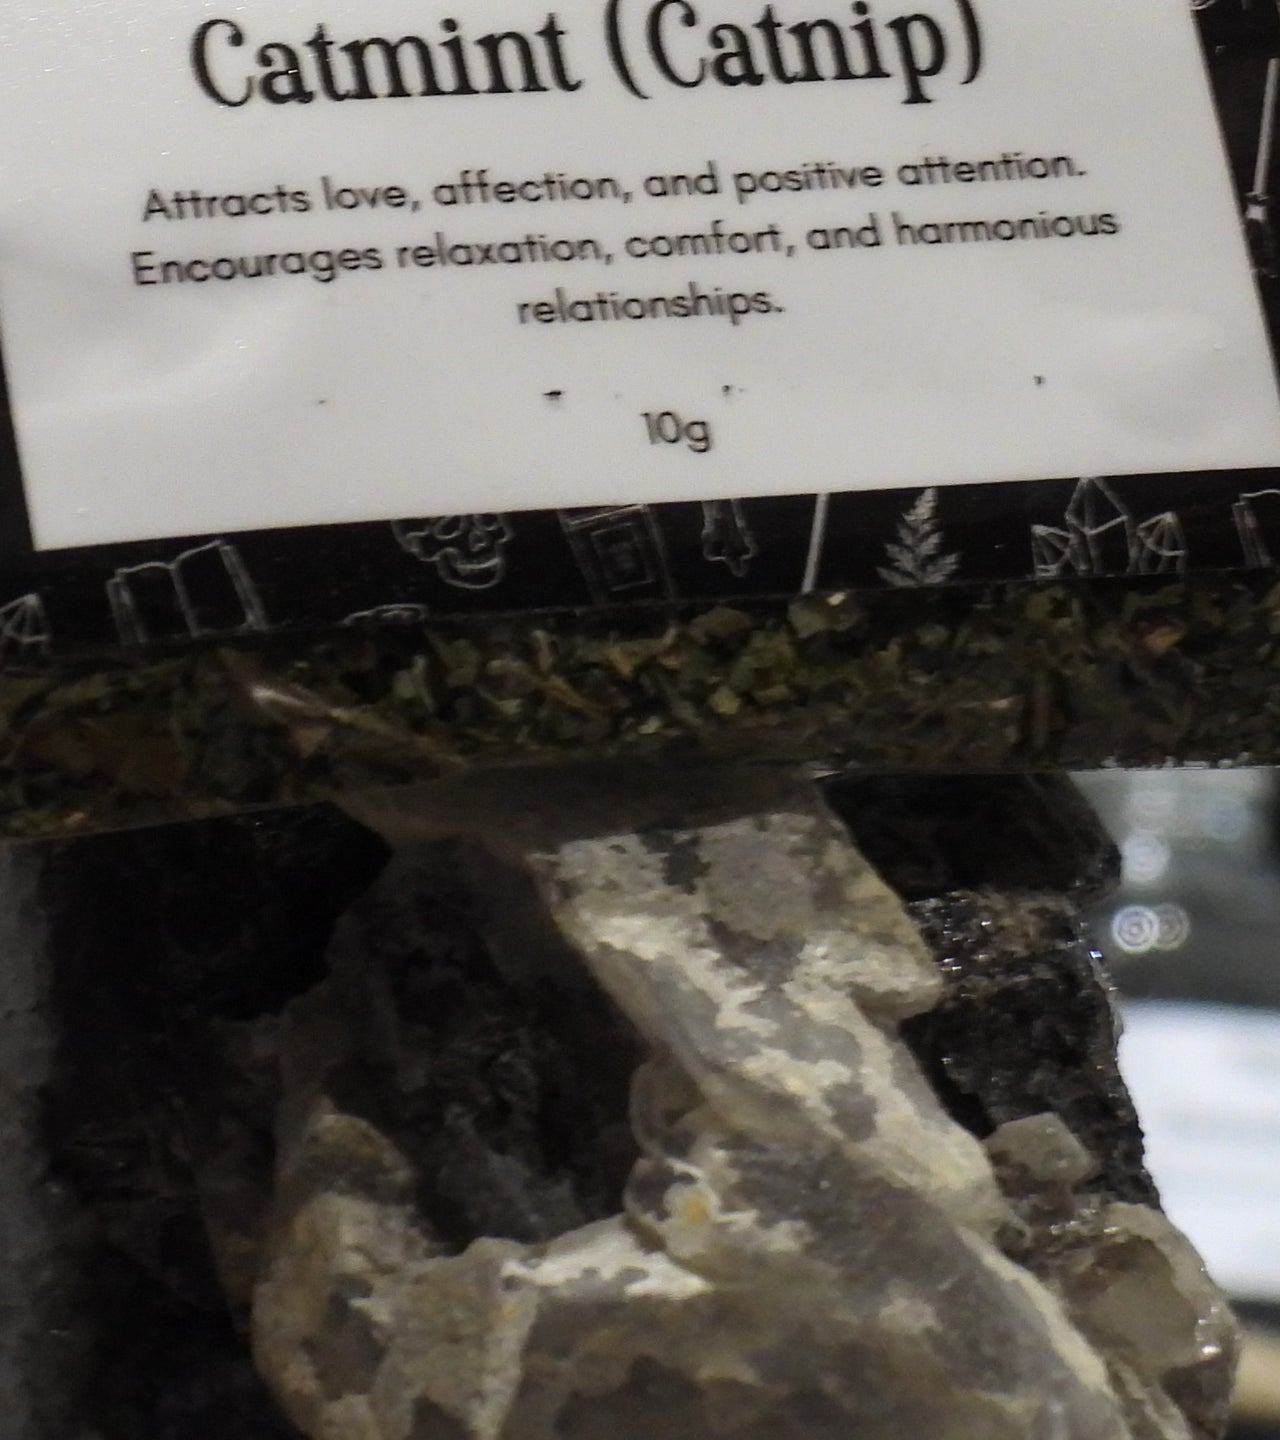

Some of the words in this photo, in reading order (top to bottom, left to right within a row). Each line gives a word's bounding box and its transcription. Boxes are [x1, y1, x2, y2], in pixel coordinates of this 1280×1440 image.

[188, 13, 586, 109] Catmint
[142, 184, 314, 222] Attracts
[320, 175, 422, 213] love,
[431, 169, 634, 206] affection,
[643, 160, 723, 198] and
[732, 161, 886, 205] positive
[897, 152, 1088, 187] attention.
[130, 248, 385, 287] Encourages
[396, 231, 615, 268] relaxation,
[624, 219, 797, 258] comfort,
[806, 211, 882, 250] and
[891, 210, 1122, 246] harmonious
[517, 280, 786, 327] relationships.
[640, 410, 713, 455] 10g
